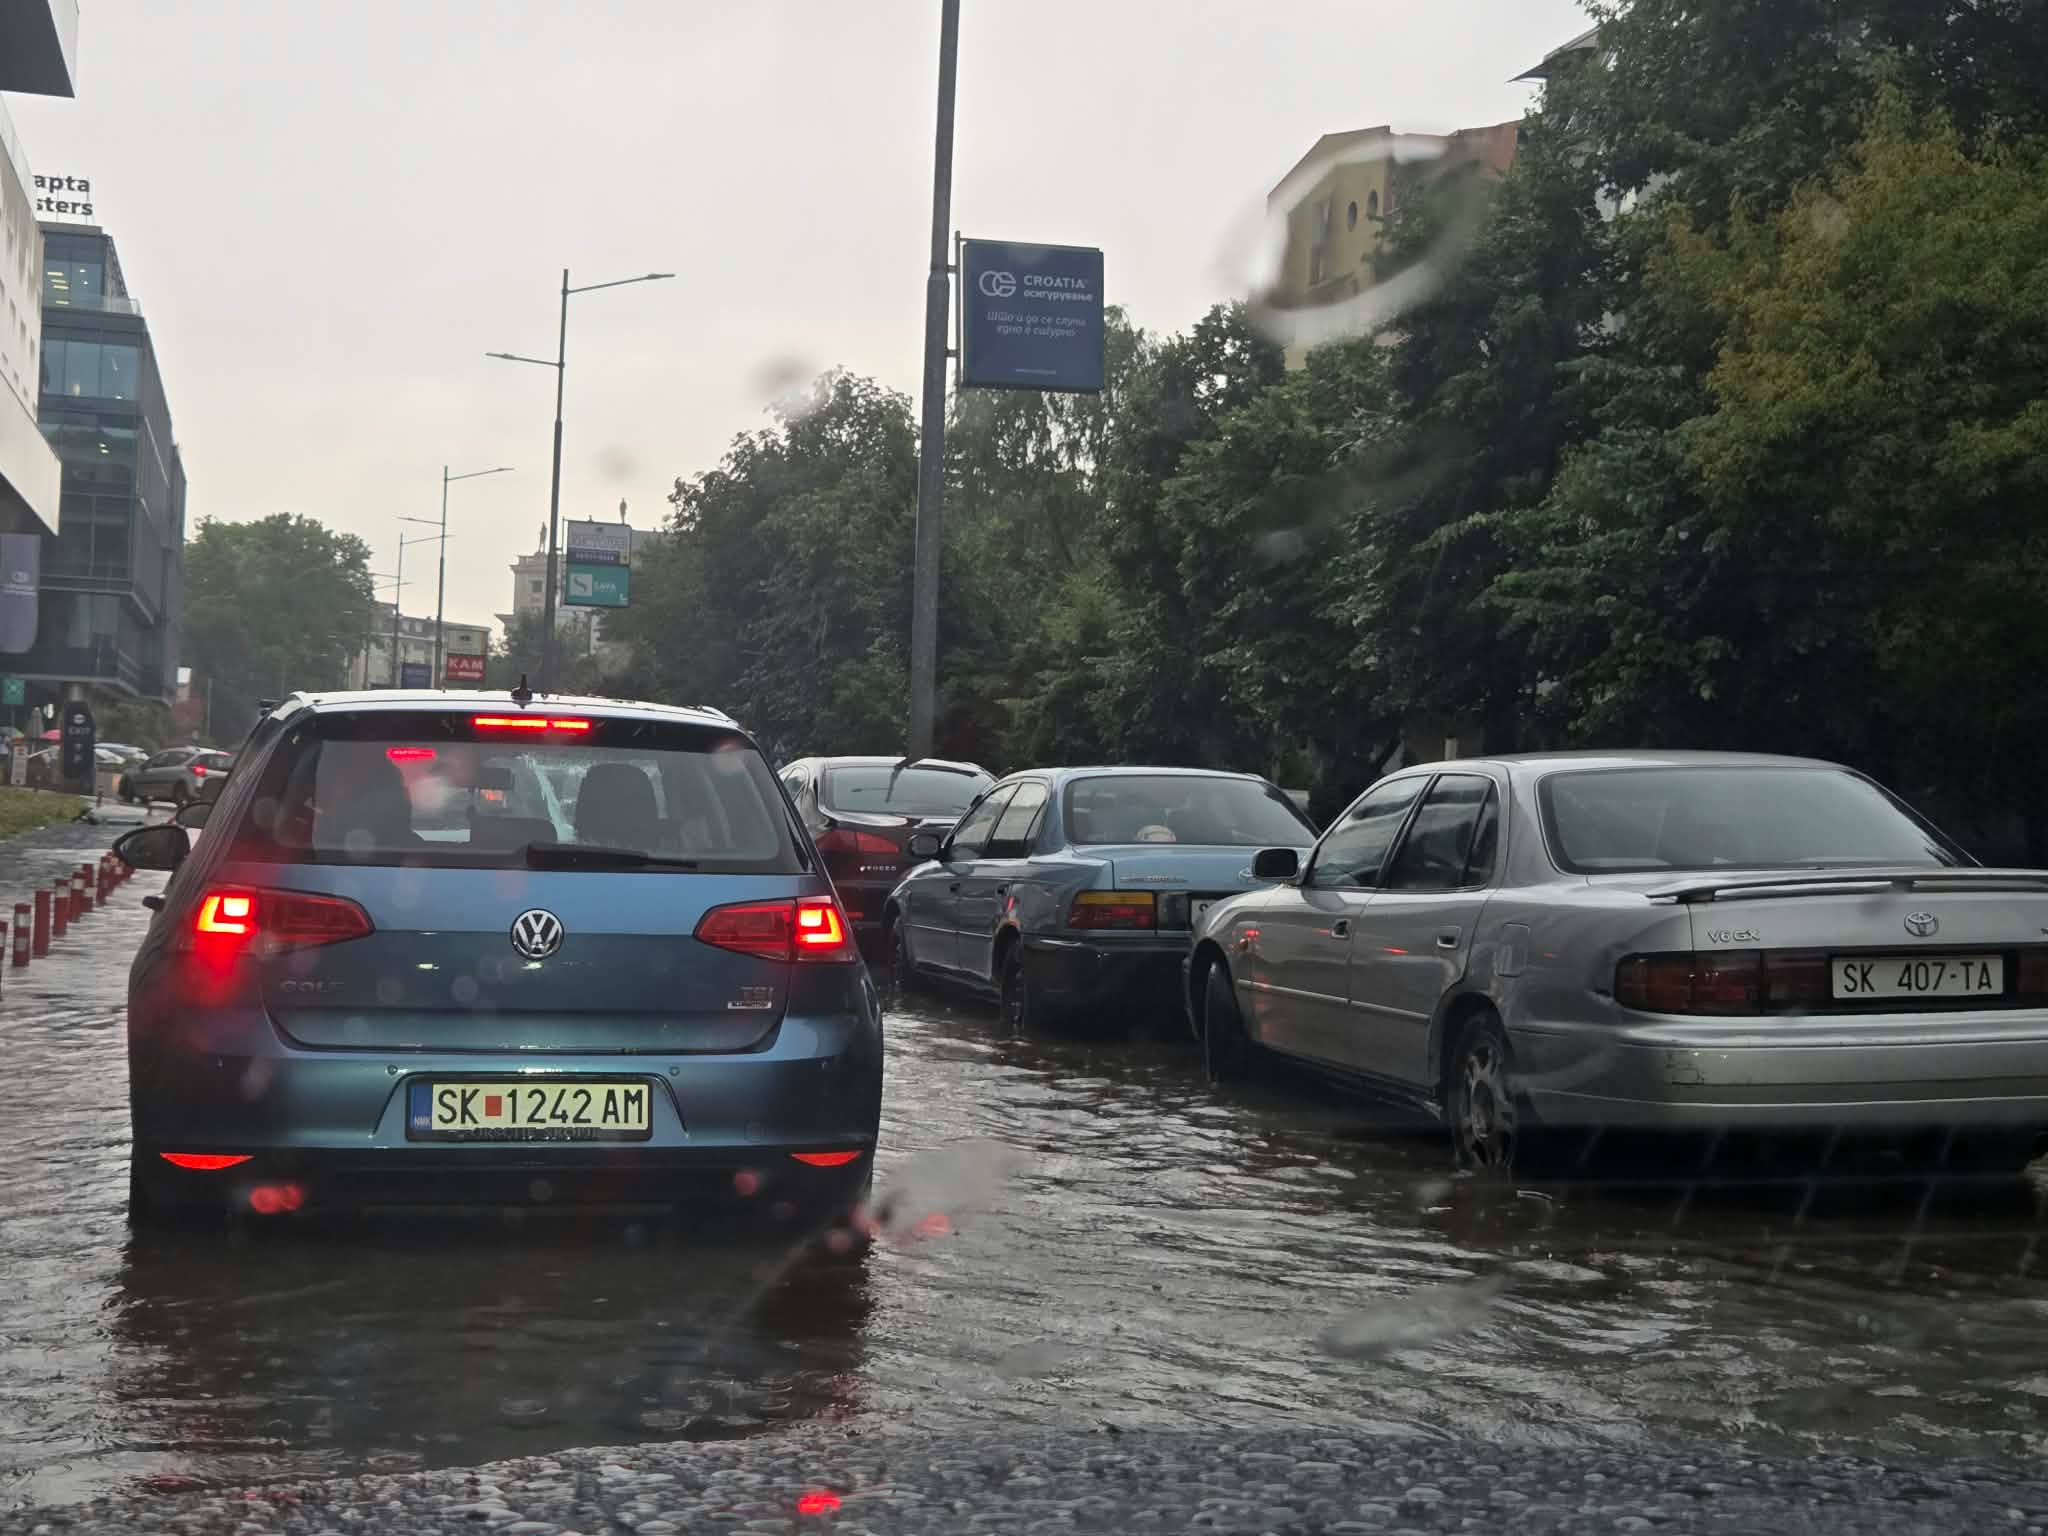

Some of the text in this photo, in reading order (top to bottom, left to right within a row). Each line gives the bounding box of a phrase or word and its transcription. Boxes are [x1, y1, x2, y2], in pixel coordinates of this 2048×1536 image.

[1023, 275, 1086, 289] CROATIA
[1842, 961, 1993, 993] SK 407-TA
[437, 1088, 644, 1125] SK 1242 AM
